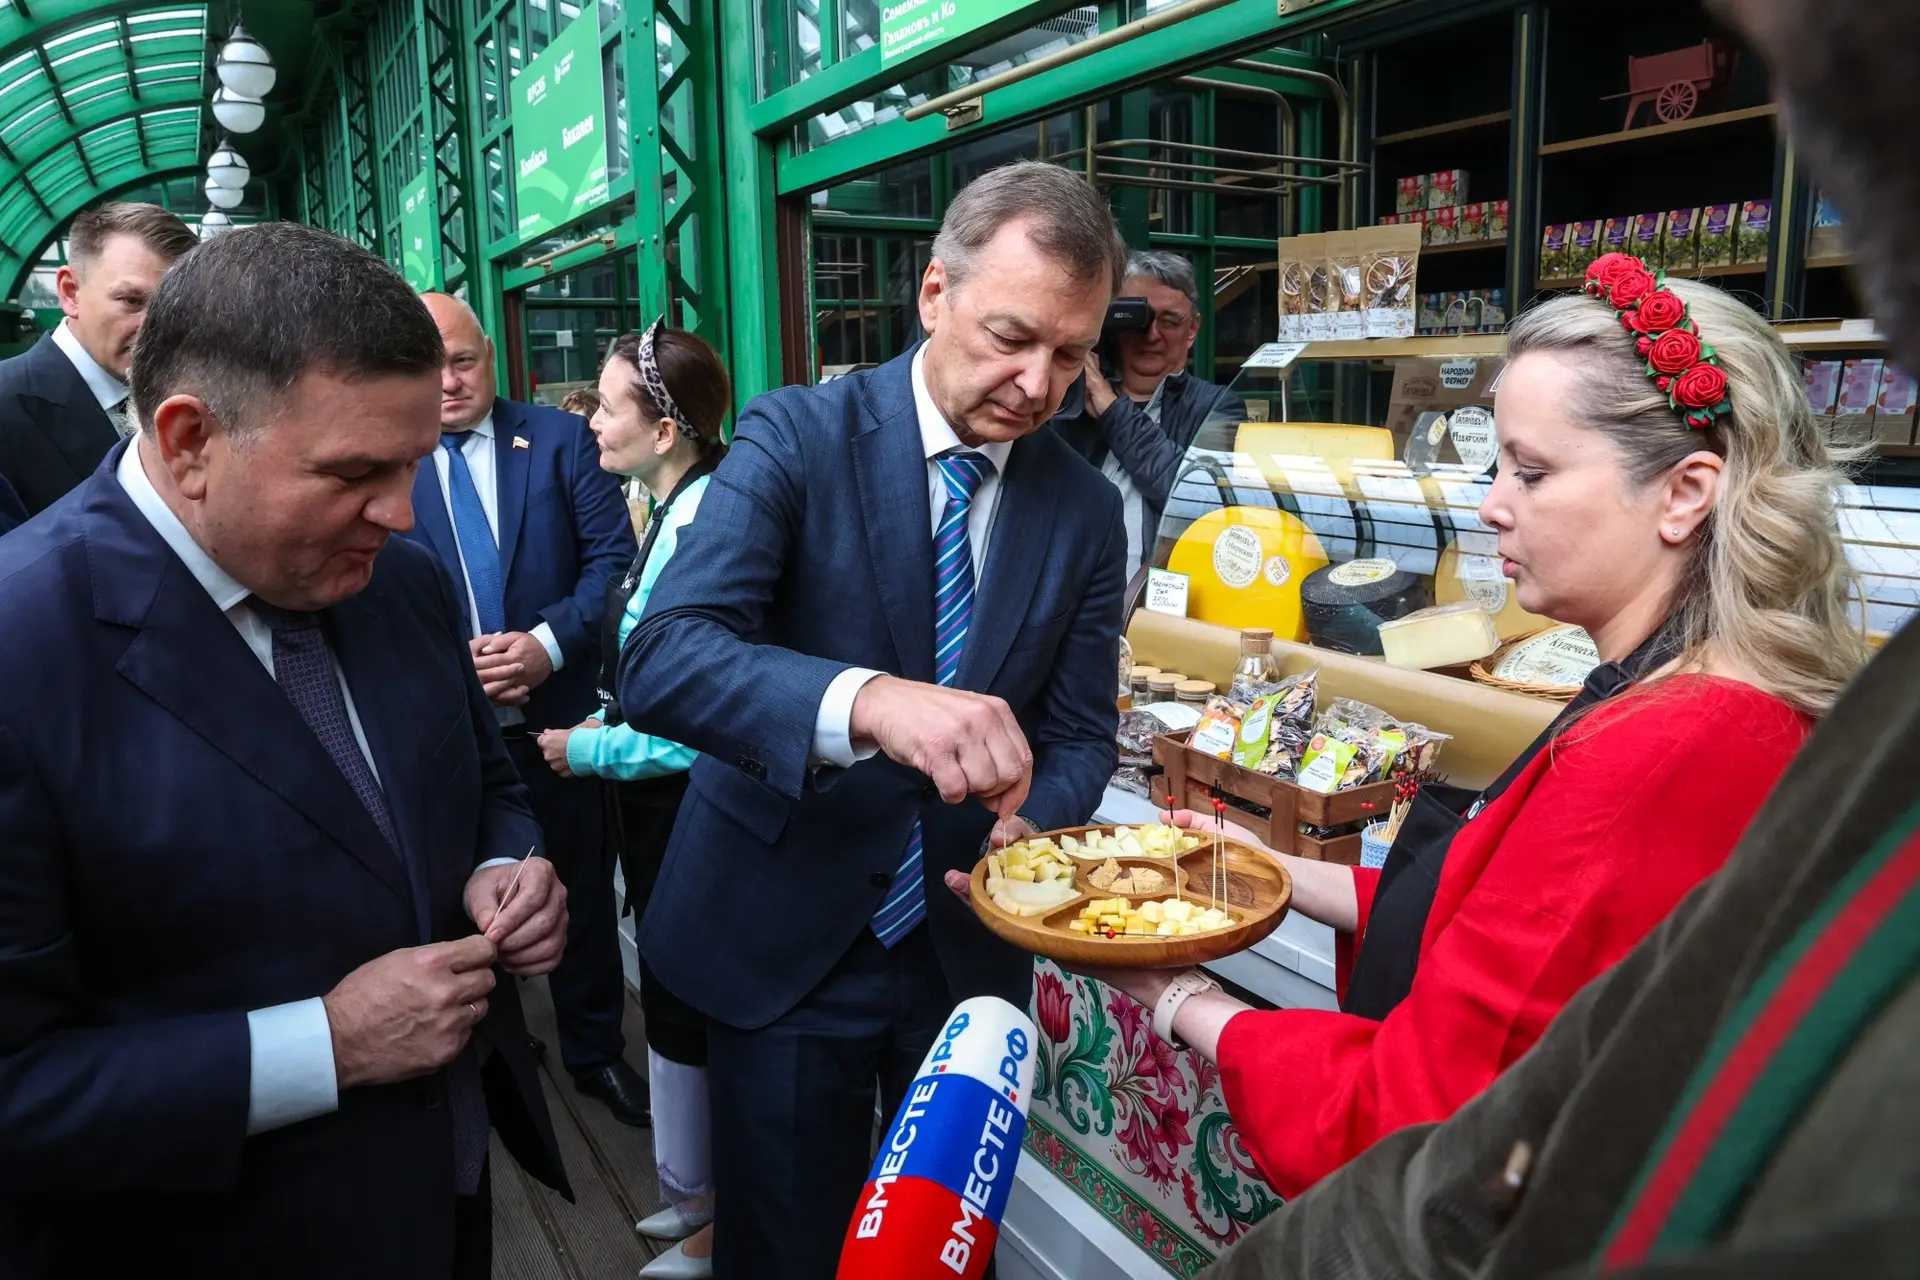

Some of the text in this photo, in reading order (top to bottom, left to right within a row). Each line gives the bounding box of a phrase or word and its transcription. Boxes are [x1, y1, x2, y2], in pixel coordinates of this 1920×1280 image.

[931, 11, 940, 24] и
[941, 2, 956, 20] Ко
[1441, 366, 1475, 377] НАРОДНЫЙ
[1444, 377, 1469, 385] ФЕРМЕР
